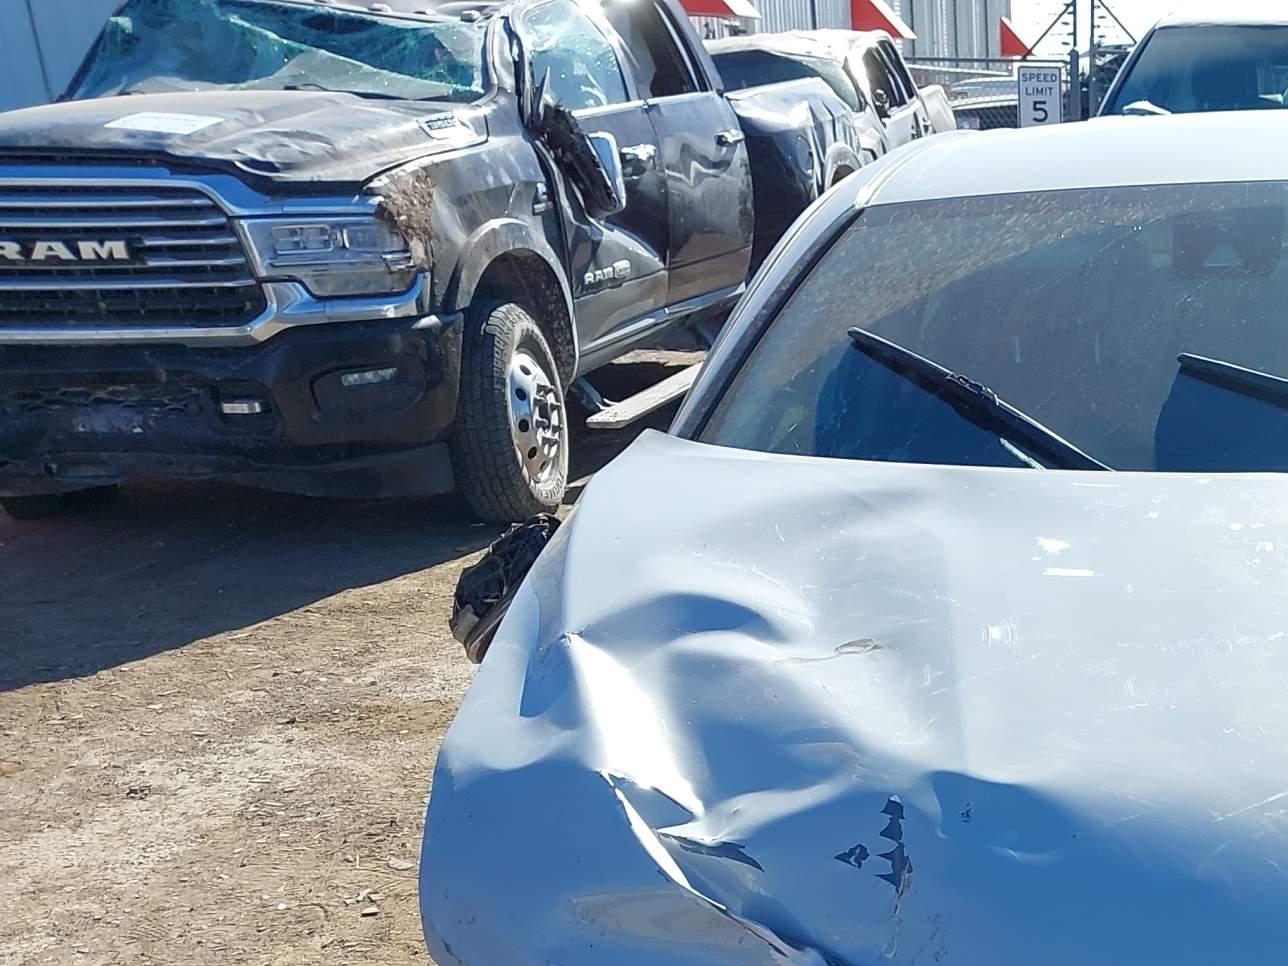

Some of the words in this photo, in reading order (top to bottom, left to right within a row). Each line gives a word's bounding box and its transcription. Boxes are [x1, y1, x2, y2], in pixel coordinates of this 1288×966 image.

[1021, 73, 1058, 83] SPEED
[1025, 87, 1053, 96] LIMIT
[1032, 101, 1048, 122] 5
[0, 240, 130, 260] RAM
